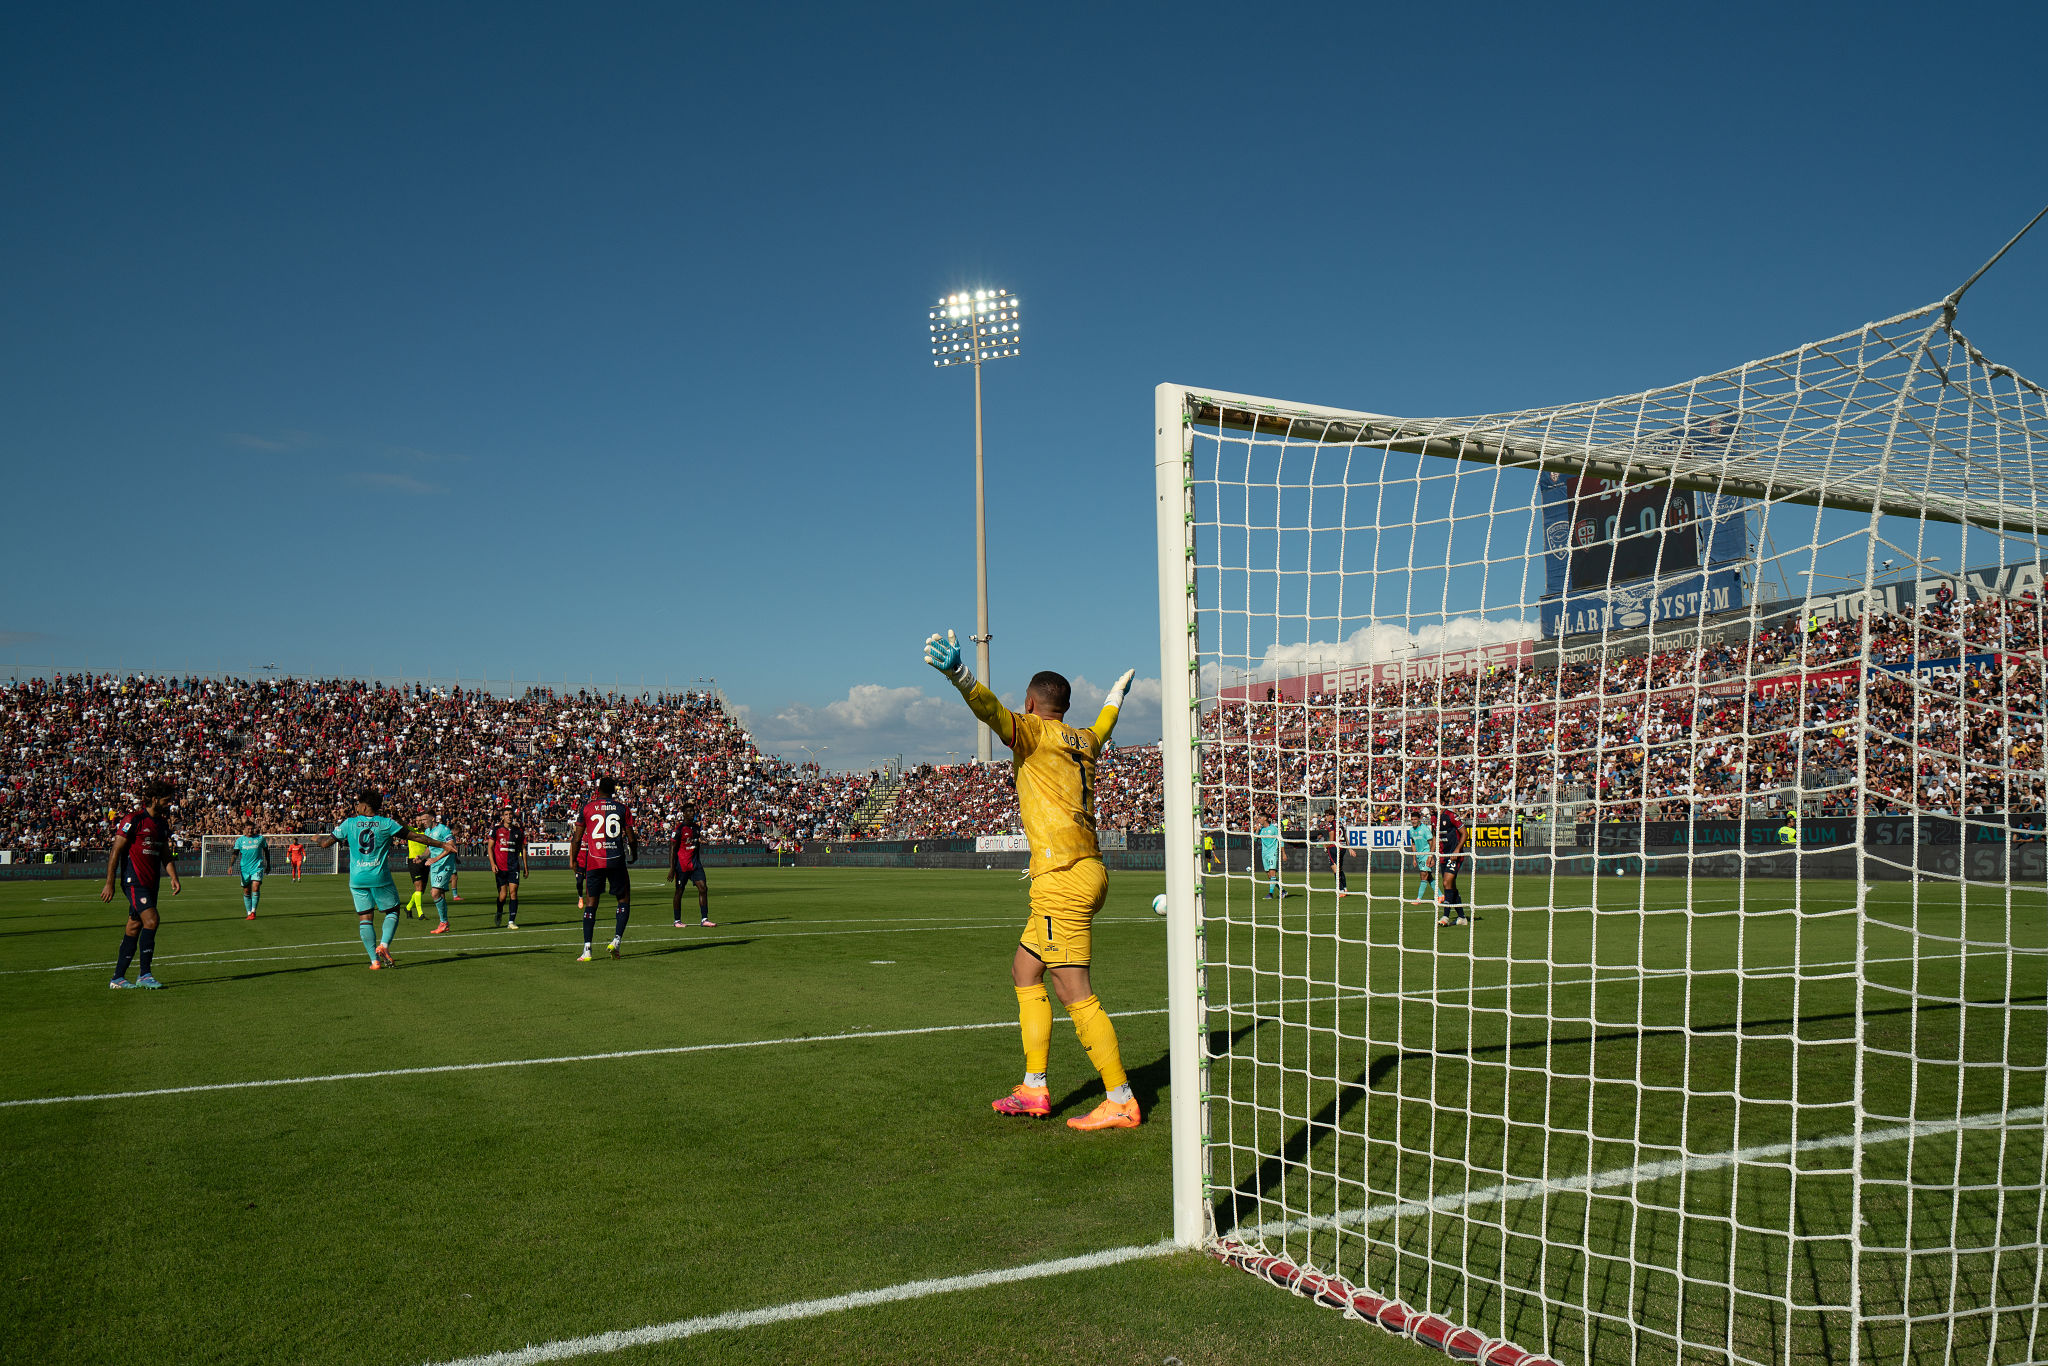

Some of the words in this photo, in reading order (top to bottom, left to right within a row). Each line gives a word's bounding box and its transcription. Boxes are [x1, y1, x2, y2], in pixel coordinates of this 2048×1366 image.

[1553, 605, 1615, 636] ALARM
[1650, 587, 1730, 621] SYSTEM
[1382, 646, 1507, 686] SEMPRE
[590, 813, 620, 840] 26
[1349, 830, 1367, 846] BE
[358, 828, 375, 855] 9
[530, 843, 568, 856] Teikos
[1120, 854, 1162, 868] TORINO
[1044, 916, 1053, 941] 1
